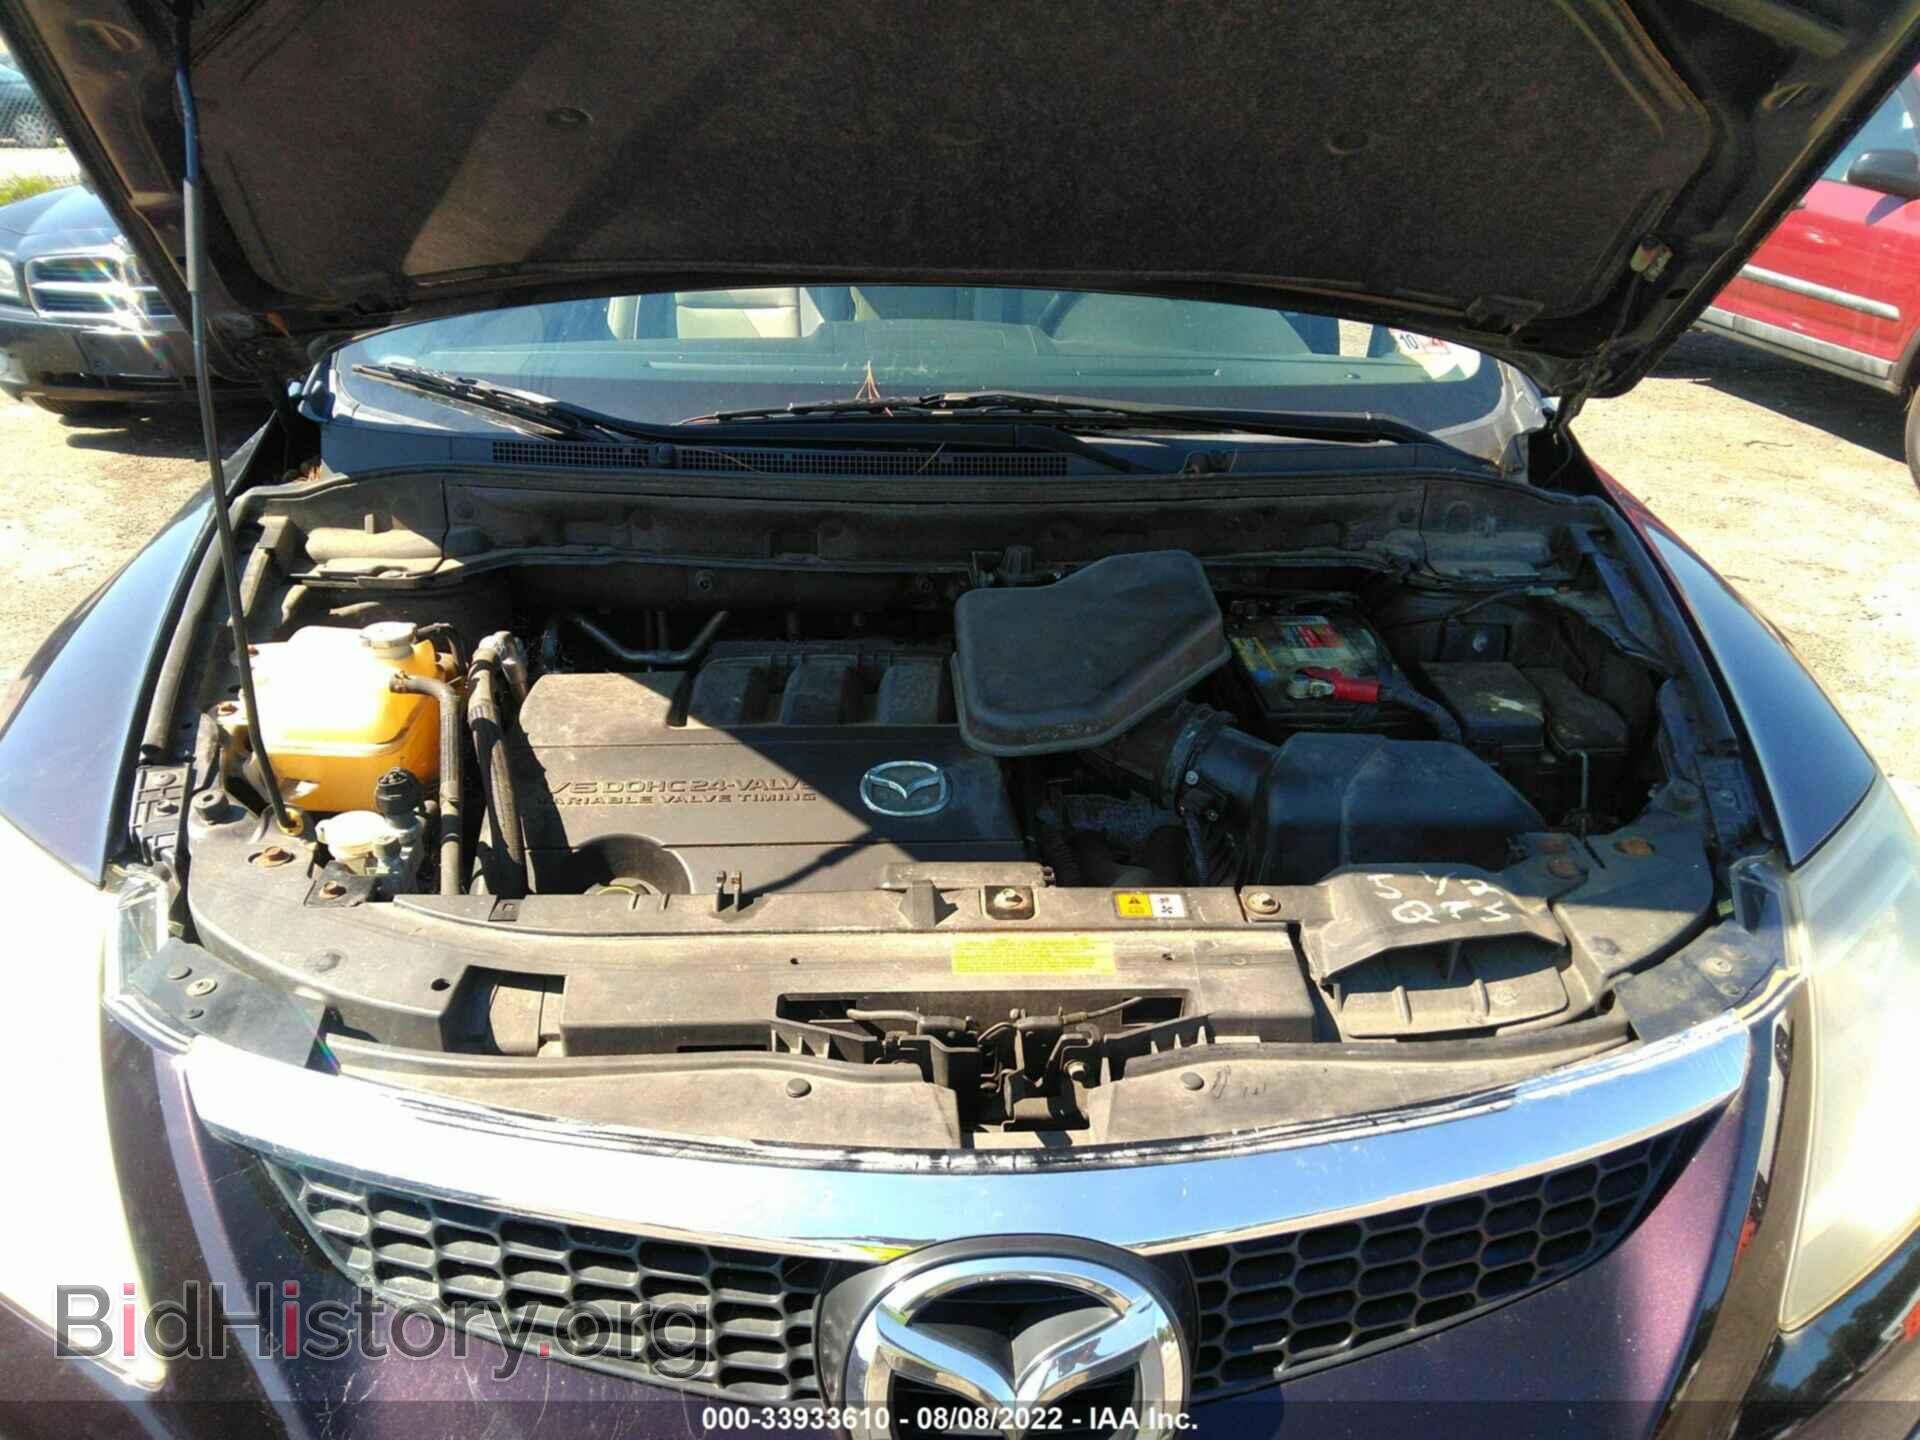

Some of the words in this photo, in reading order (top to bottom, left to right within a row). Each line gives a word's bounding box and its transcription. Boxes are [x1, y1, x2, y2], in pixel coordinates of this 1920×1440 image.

[602, 780, 686, 794] DOHC
[661, 794, 731, 804] VALVE
[737, 792, 817, 803] TIMING
